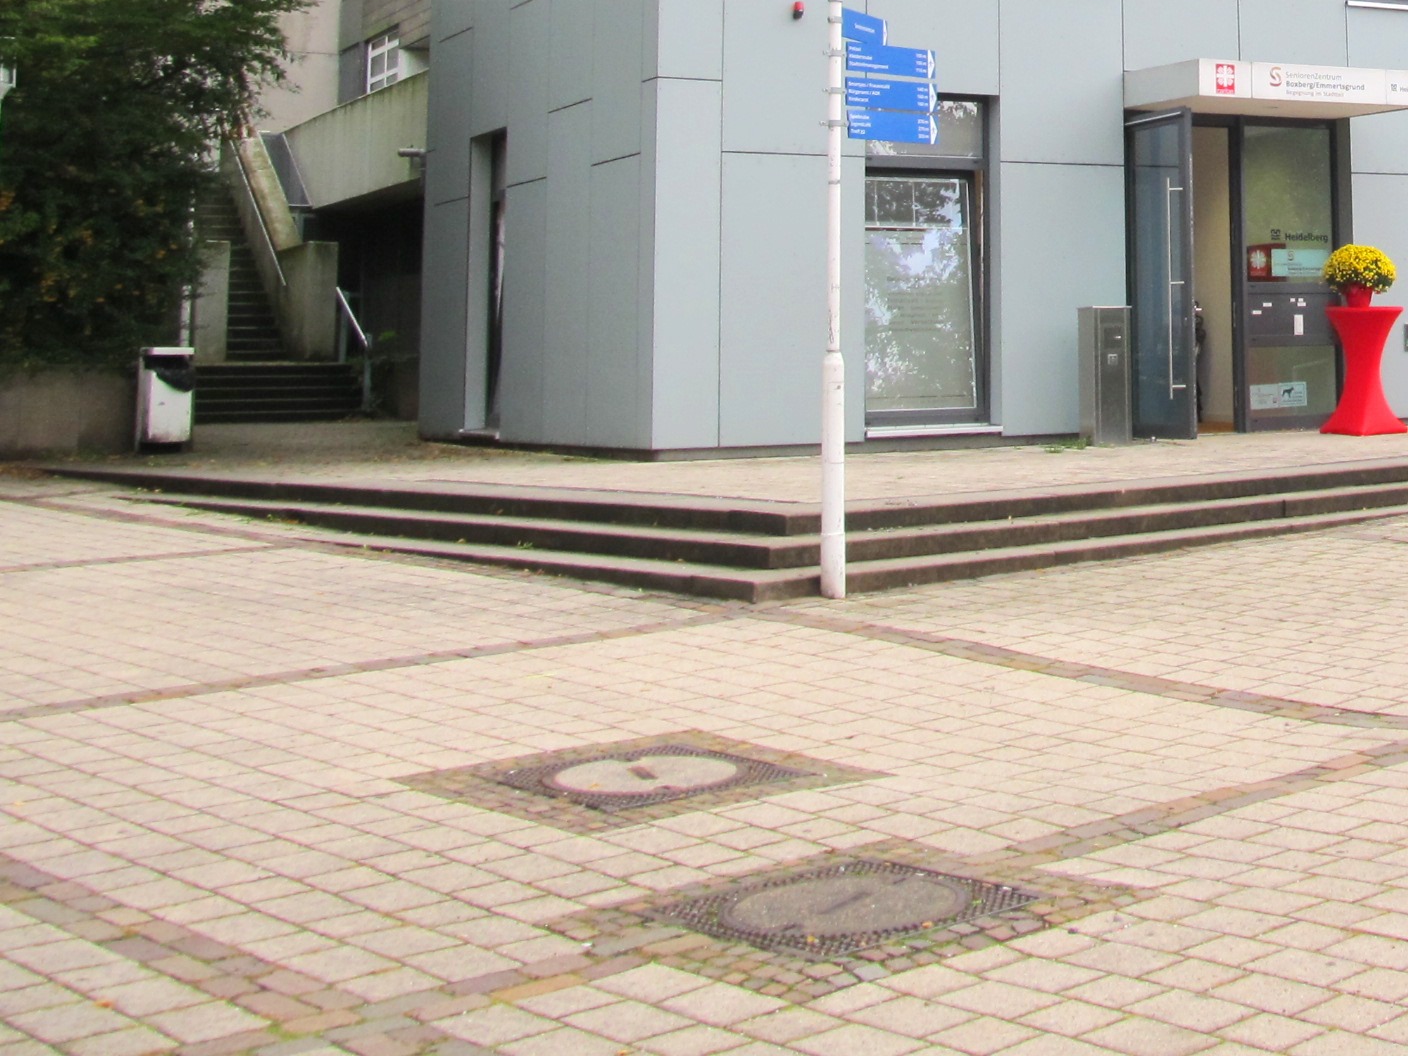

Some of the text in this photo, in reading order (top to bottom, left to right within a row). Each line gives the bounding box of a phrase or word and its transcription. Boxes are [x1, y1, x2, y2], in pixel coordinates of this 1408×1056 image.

[1285, 70, 1343, 81] SeniorenZentrum
[1285, 80, 1365, 91] Boxberg/Emmertsgrund
[1284, 232, 1329, 244] Heidelberg
